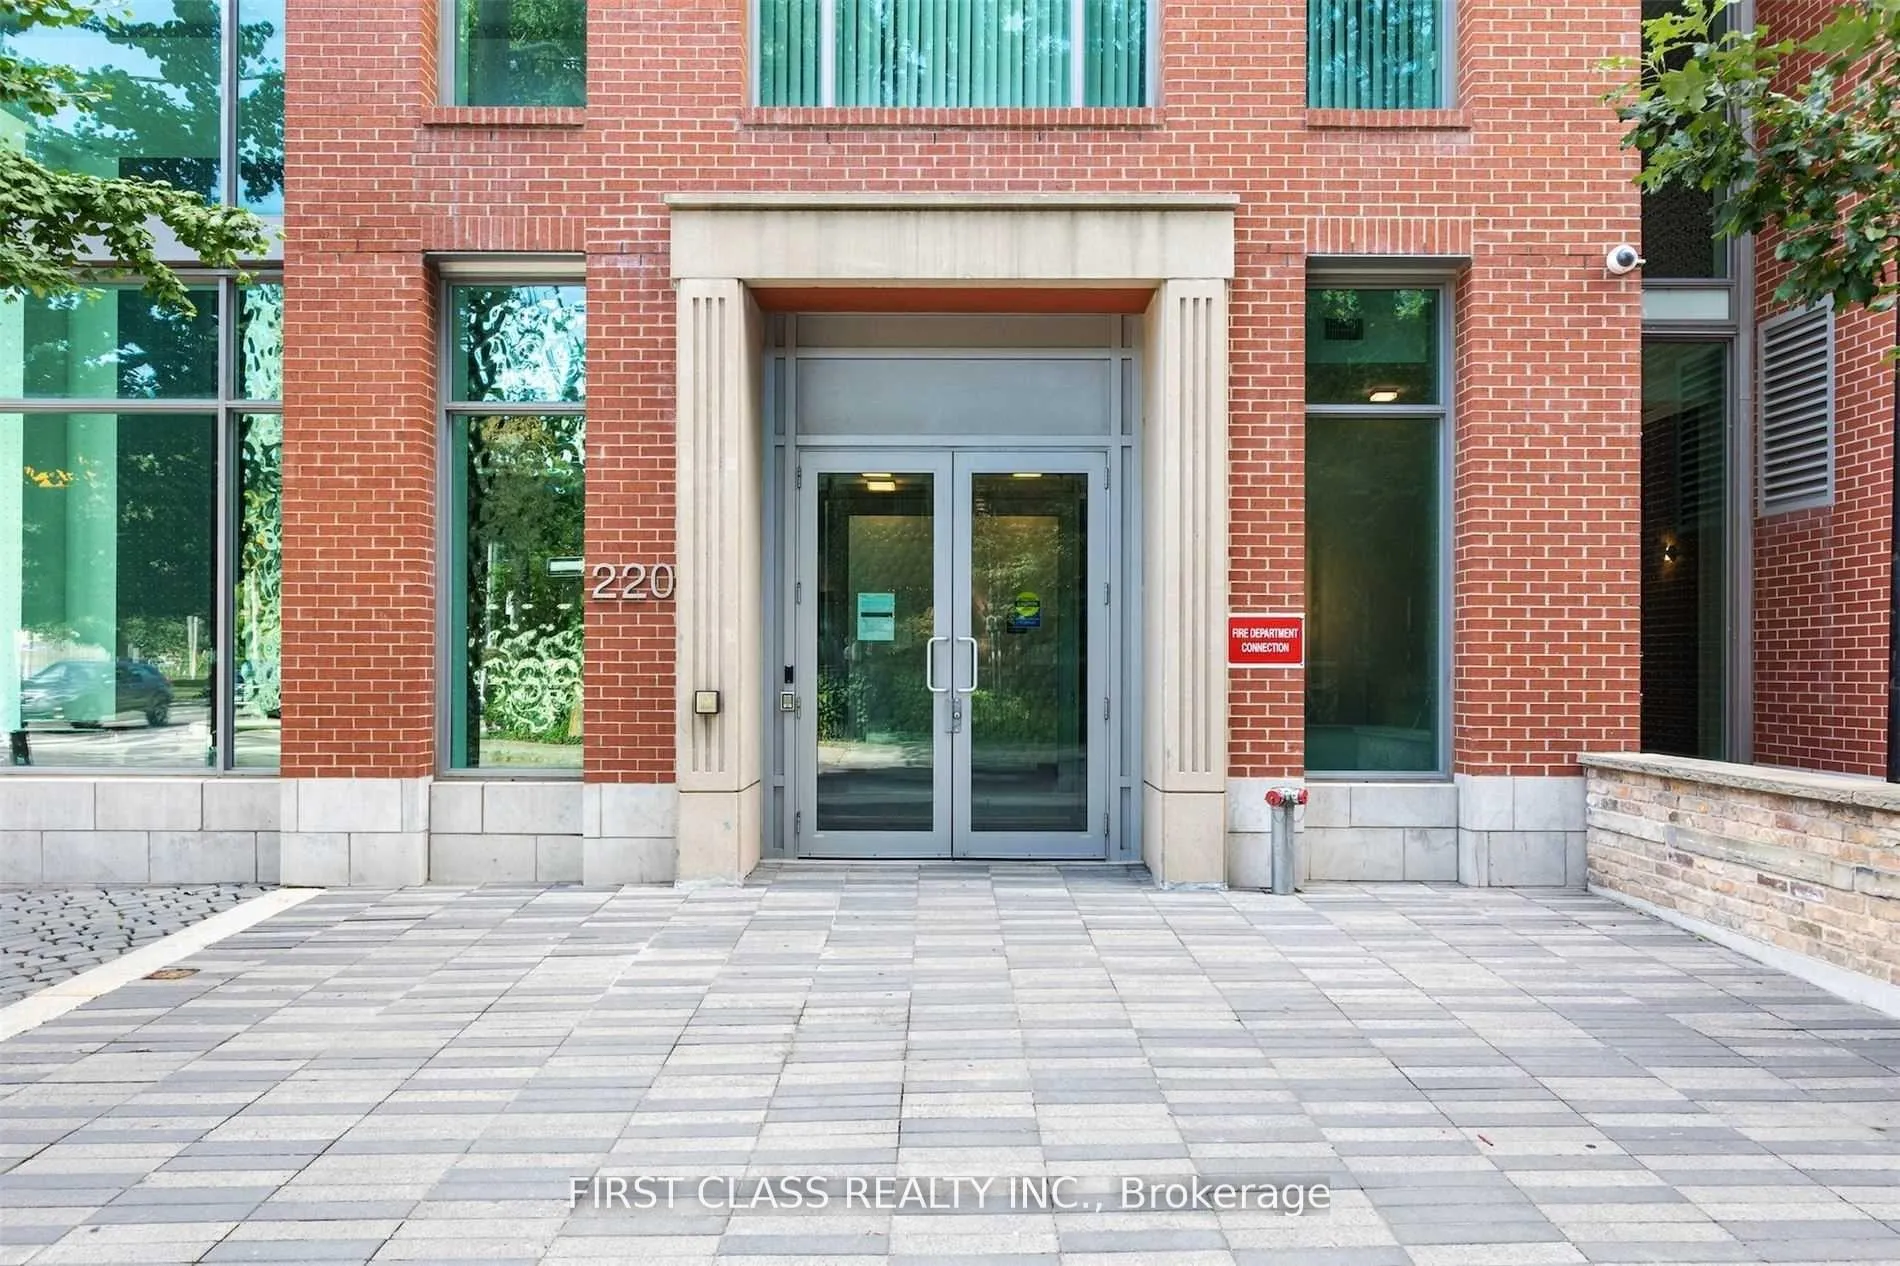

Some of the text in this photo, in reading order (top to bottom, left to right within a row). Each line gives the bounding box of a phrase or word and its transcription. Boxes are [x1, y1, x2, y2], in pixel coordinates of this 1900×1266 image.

[592, 562, 675, 599] 220
[1232, 627, 1299, 639] FIRE DEPARTMENT
[1241, 642, 1290, 653] CONNECTION
